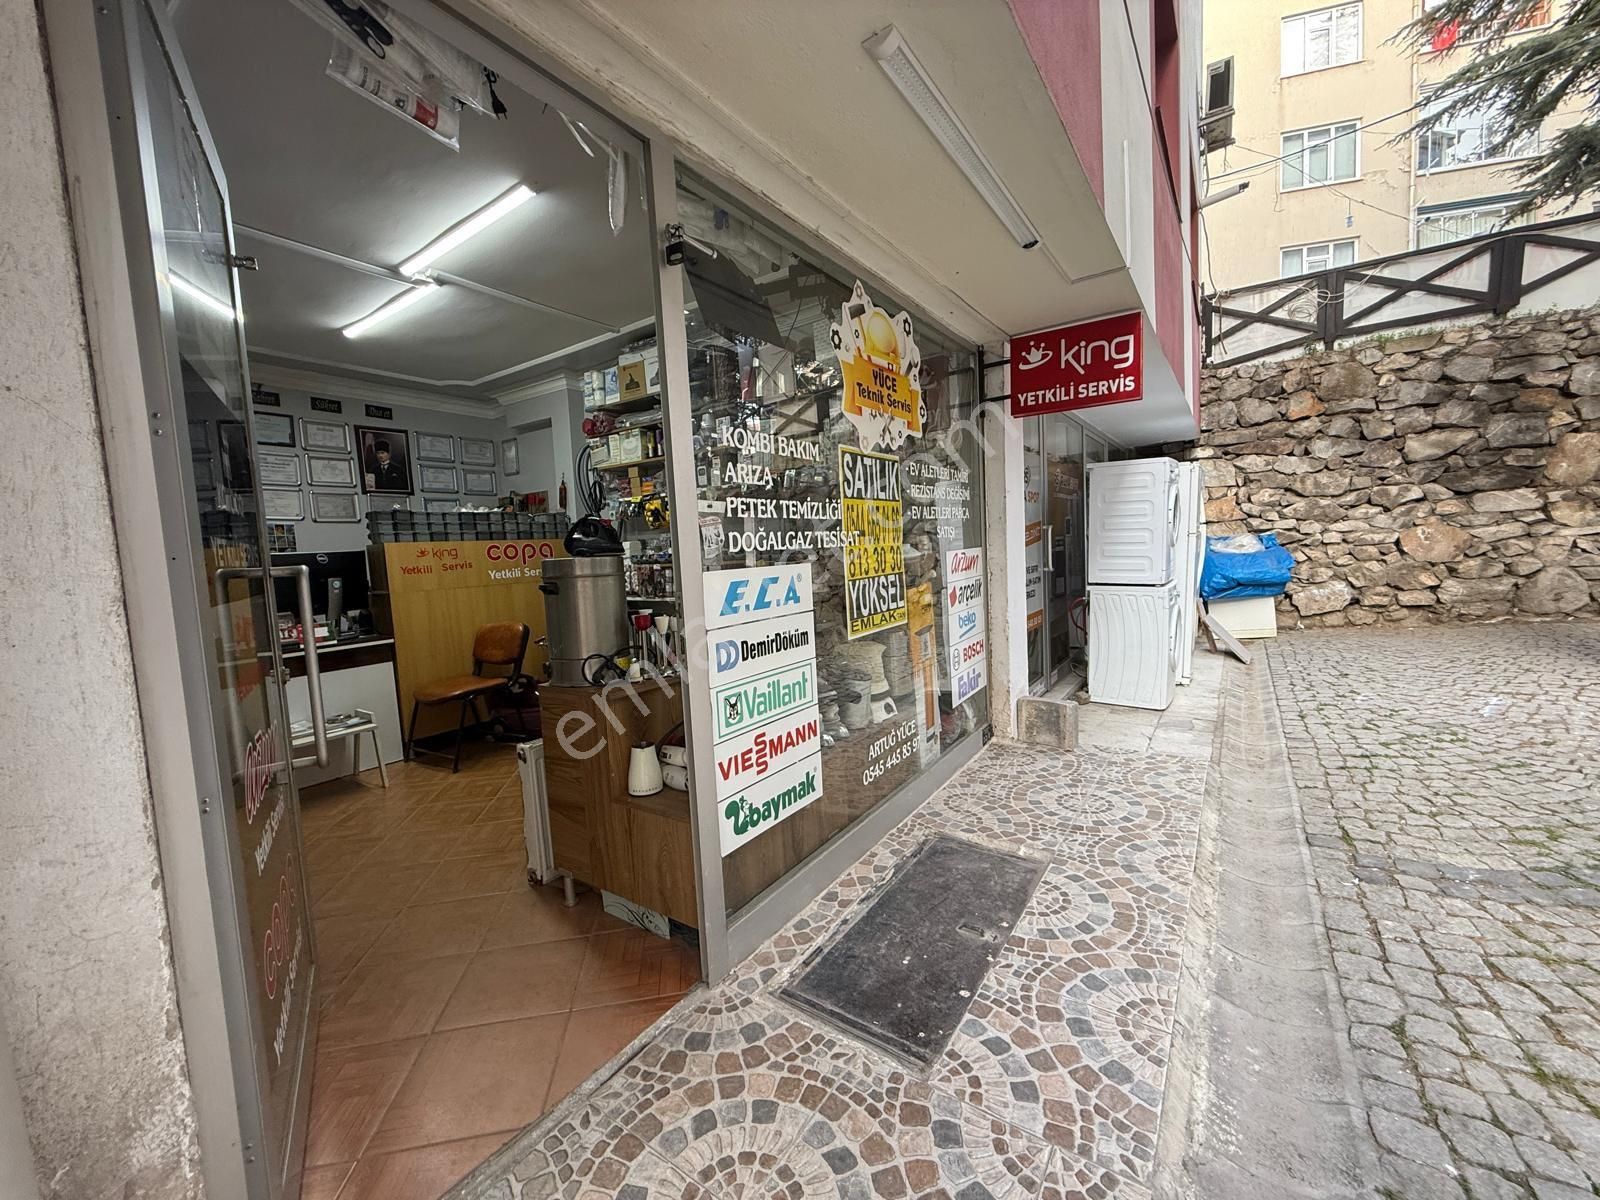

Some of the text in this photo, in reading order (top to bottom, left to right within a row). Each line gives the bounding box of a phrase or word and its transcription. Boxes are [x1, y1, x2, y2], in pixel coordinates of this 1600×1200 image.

[1061, 334, 1135, 375] king
[872, 367, 897, 393] YÜCE
[1018, 374, 1136, 407] YETKİLİ SERVİS
[856, 382, 912, 414] Teknik Servis
[778, 436, 820, 462] BAKIM
[724, 461, 774, 487] ARIZA
[843, 453, 899, 500] SATILIK
[910, 462, 920, 476] EV
[921, 464, 950, 480] ALETLERİ
[726, 496, 841, 520] PETEK TEMİZLİĞİ
[912, 506, 921, 519] EV
[922, 503, 951, 519] ALETLERİ
[728, 526, 814, 553] DOĞALGAZ
[432, 547, 458, 560] king
[486, 542, 554, 565] copa
[848, 545, 902, 579] 813 30 30
[951, 552, 979, 576] arzum
[400, 561, 473, 575] Yetkili Servis
[488, 567, 521, 580] Yetkili
[848, 574, 905, 619] YÜKSEL
[958, 577, 983, 606] arçelik
[851, 610, 897, 633] EMLAK
[958, 610, 976, 630] beko
[741, 627, 809, 662] DemirDöküm
[963, 639, 984, 663] BOSCH
[743, 670, 809, 720] Vaillant
[958, 667, 982, 700] Fakir
[718, 720, 818, 782] VIESSMANN
[868, 720, 917, 761] ARTUĞ YÜCE
[863, 759, 885, 786] 0545
[885, 748, 901, 769] 445
[902, 741, 912, 759] 85
[748, 769, 817, 829] baymak
